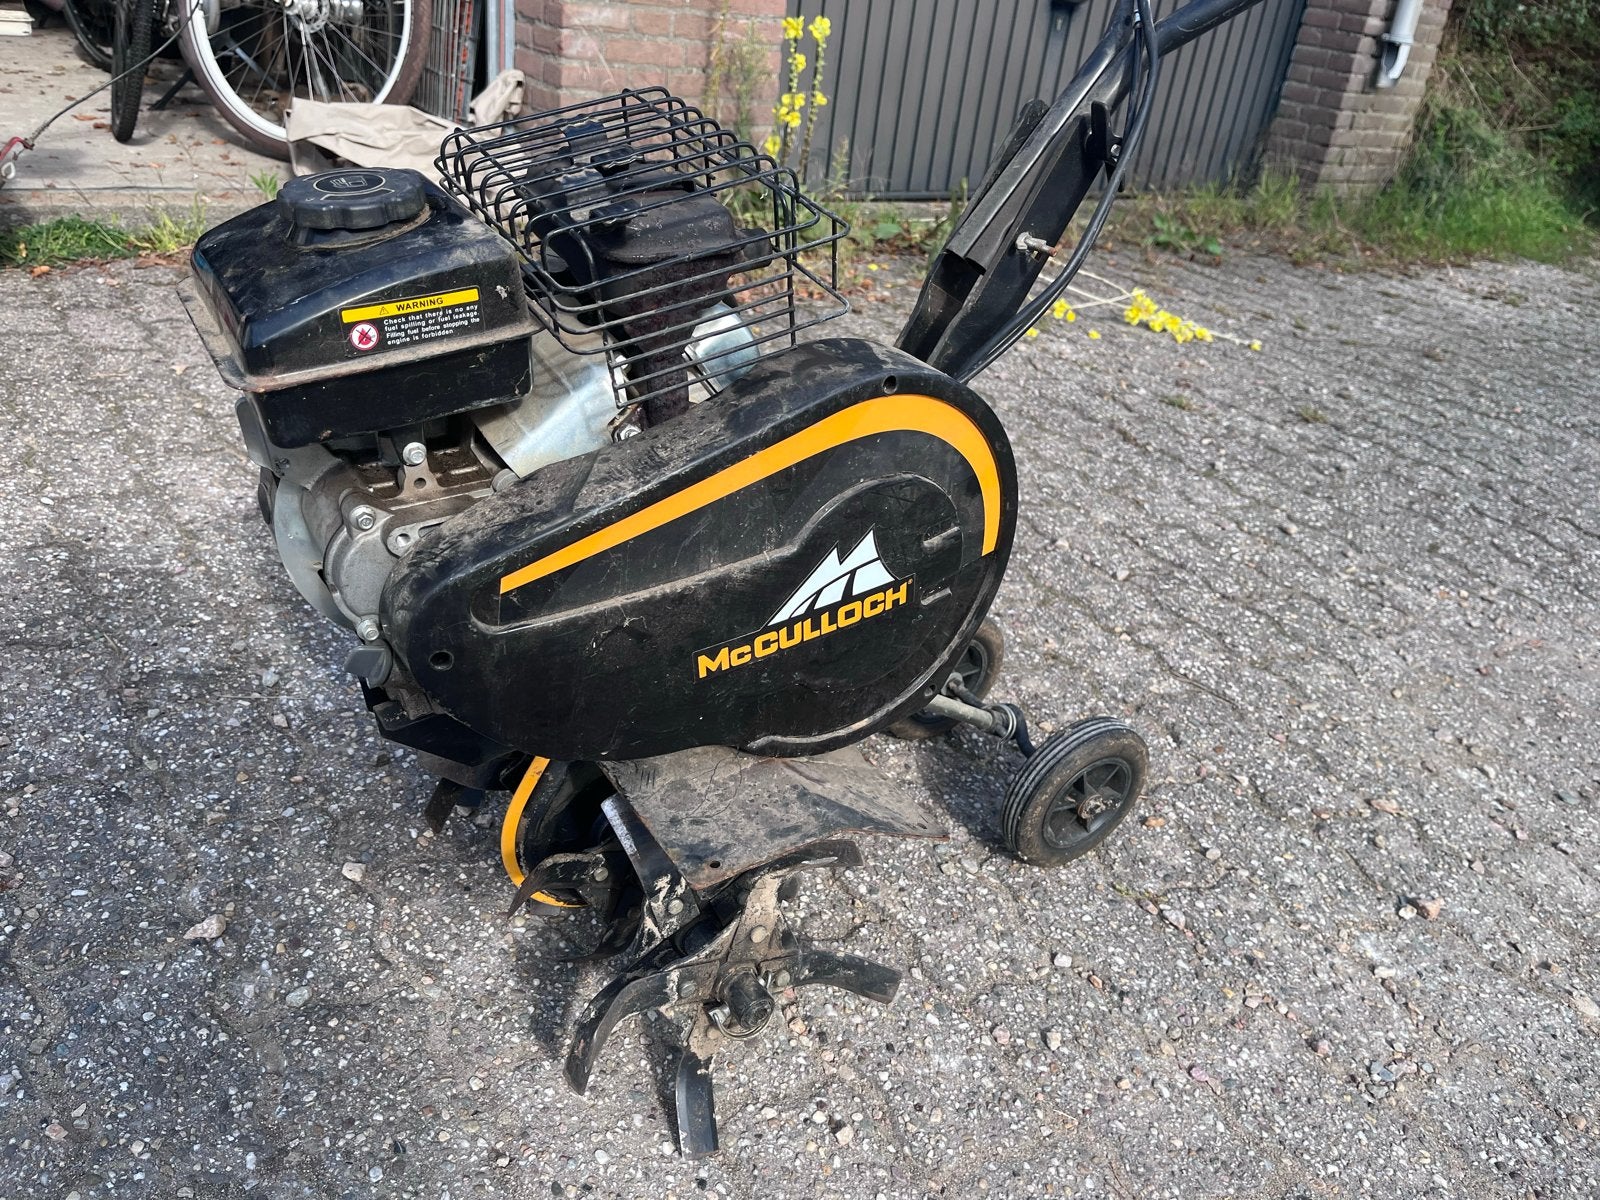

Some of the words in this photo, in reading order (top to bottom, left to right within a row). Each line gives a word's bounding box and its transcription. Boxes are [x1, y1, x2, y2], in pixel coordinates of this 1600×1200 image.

[396, 297, 444, 312] WARNING
[384, 316, 406, 326] Check
[408, 314, 423, 322] that
[425, 310, 443, 319] there
[466, 304, 478, 312] any
[385, 324, 398, 332] fuel
[401, 319, 426, 330] spilling
[438, 314, 450, 322] fuel
[386, 330, 405, 339] Filling
[422, 324, 440, 332] before
[443, 320, 468, 329] stopping
[387, 336, 410, 345] engine
[422, 329, 454, 338] forbidden
[697, 582, 908, 679] McCULLOCH
